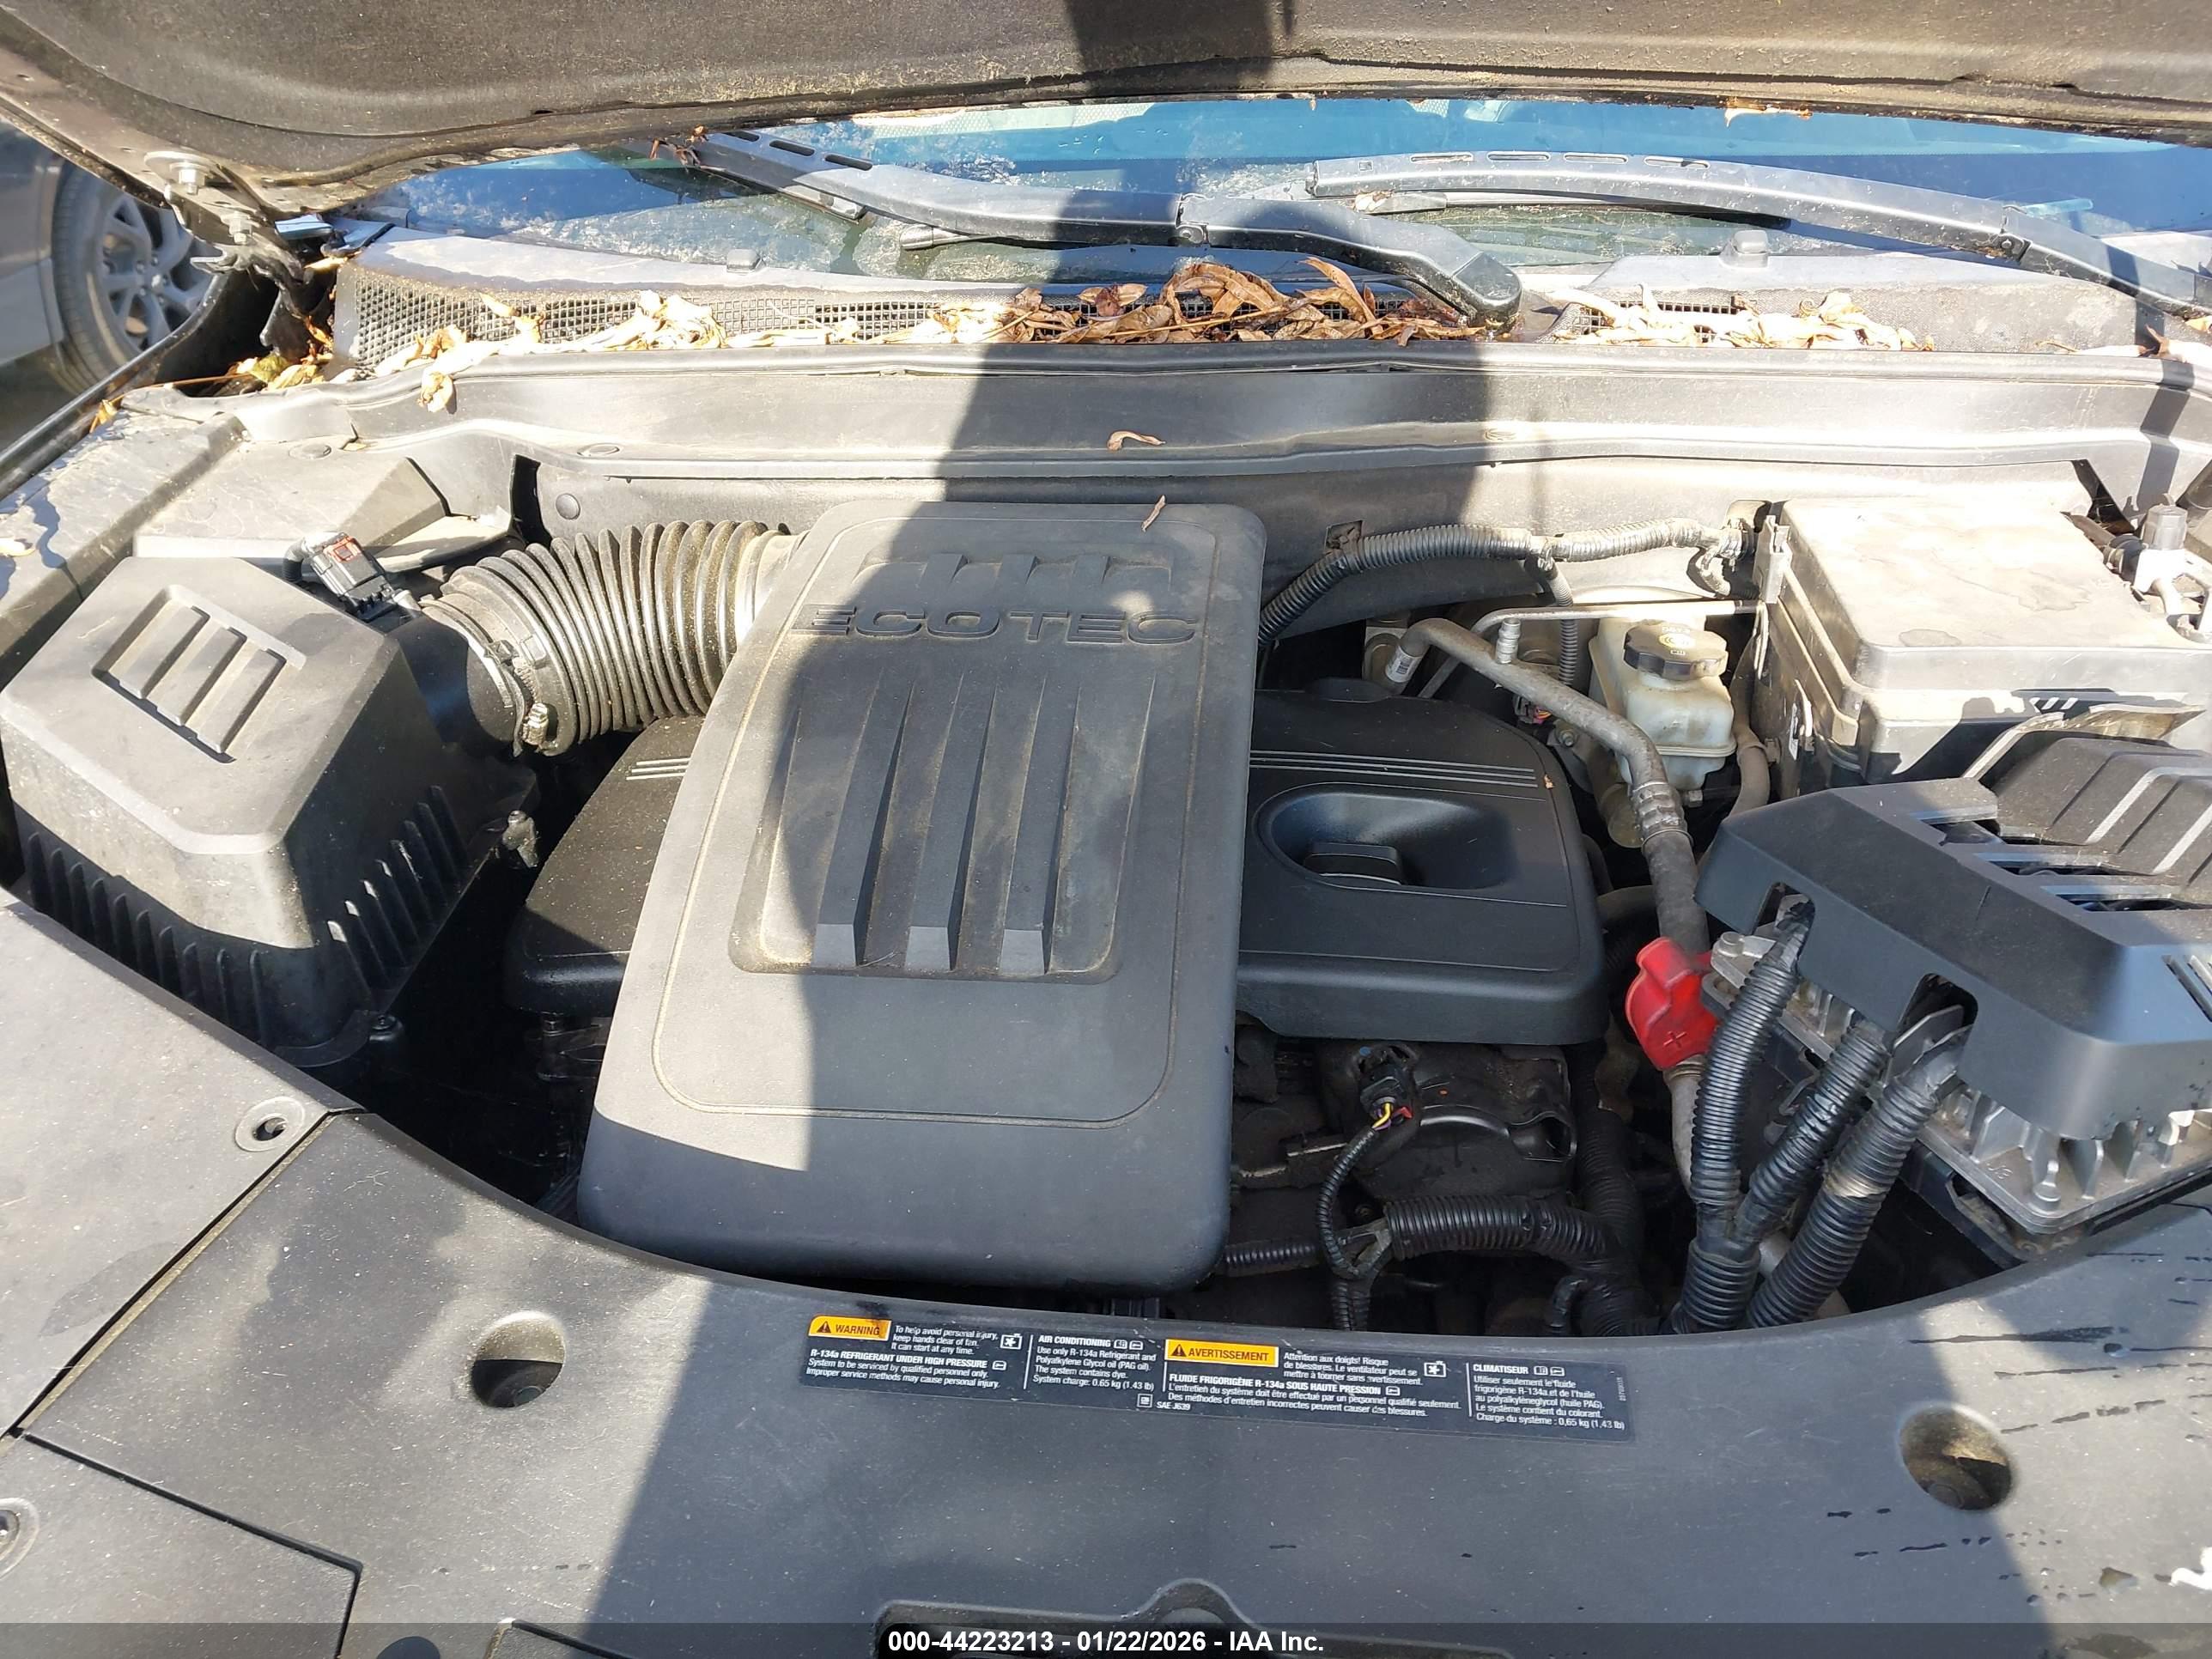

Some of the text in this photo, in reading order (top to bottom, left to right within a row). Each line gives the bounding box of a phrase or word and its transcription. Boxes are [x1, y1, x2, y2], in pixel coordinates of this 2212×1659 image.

[790, 605, 1199, 646] ECOTEC
[836, 1324, 880, 1335] WARNING
[905, 1326, 921, 1335] help
[893, 1334, 911, 1344] keep
[913, 1335, 935, 1344] hands
[965, 1338, 979, 1346] fan.
[1038, 1335, 1053, 1344] AIR
[811, 1349, 988, 1368] R-134a REFRIGERANT UNDER HIGH PRESSURE
[1053, 1348, 1069, 1357] only
[1070, 1348, 1098, 1358] R-134a
[1099, 1350, 1140, 1360] Refrigerant
[1188, 1348, 1269, 1361] AVERTISSEMENT
[1284, 1352, 1318, 1362] Attention
[1335, 1356, 1361, 1364] doigts!
[1363, 1357, 1389, 1366] Risque
[809, 1358, 836, 1367] System
[890, 1364, 900, 1373] by
[901, 1365, 933, 1374] qualified
[972, 1370, 989, 1379] only.
[1035, 1364, 1049, 1373] The
[1079, 1369, 1111, 1377] contains
[1083, 1358, 1106, 1368] Glycol
[1118, 1361, 1136, 1370] (PAG
[1138, 1363, 1151, 1371] oil).
[1296, 1362, 1334, 1371] blessures.
[1346, 1365, 1388, 1375] ventilateur
[1474, 1364, 1529, 1374] CLIMATISEUR
[806, 1368, 841, 1377] Improper
[869, 1372, 902, 1381] methods
[977, 1379, 1000, 1389] injury.
[1033, 1375, 1061, 1384] System
[1092, 1378, 1110, 1387] 0.65
[1111, 1380, 1121, 1389] kg
[1123, 1381, 1143, 1389] (1.43
[1145, 1382, 1155, 1391] lb)
[1317, 1372, 1346, 1381] tourner
[1474, 1376, 1501, 1384] Utiliser
[1170, 1374, 1382, 1395] FLUIDE FRIGORIGÈNE R-134a SOUS HAUTE PRESSION
[1474, 1385, 1516, 1395] frigorigène
[1518, 1387, 1548, 1395] R-134a
[1169, 1383, 1209, 1393] L'entretien
[1222, 1388, 1254, 1396] système
[1255, 1389, 1271, 1397] doit
[1289, 1391, 1321, 1400] effectué
[1419, 1400, 1462, 1409] seulement.
[1185, 1395, 1223, 1403] méthodes
[1224, 1396, 1266, 1406] d'entretien
[1267, 1399, 1310, 1409] incorrectes
[1388, 1407, 1429, 1417] blessures.
[1560, 1399, 1582, 1407] (huile
[1583, 1401, 1605, 1410] PAG).
[1487, 1405, 1521, 1413] système
[1522, 1407, 1554, 1415] contient
[1569, 1409, 1603, 1418] colorant.
[1477, 1413, 1505, 1423] Charge
[1519, 1416, 1553, 1425] système
[1579, 1419, 1589, 1428] kg
[1613, 1421, 1625, 1431] lb)
